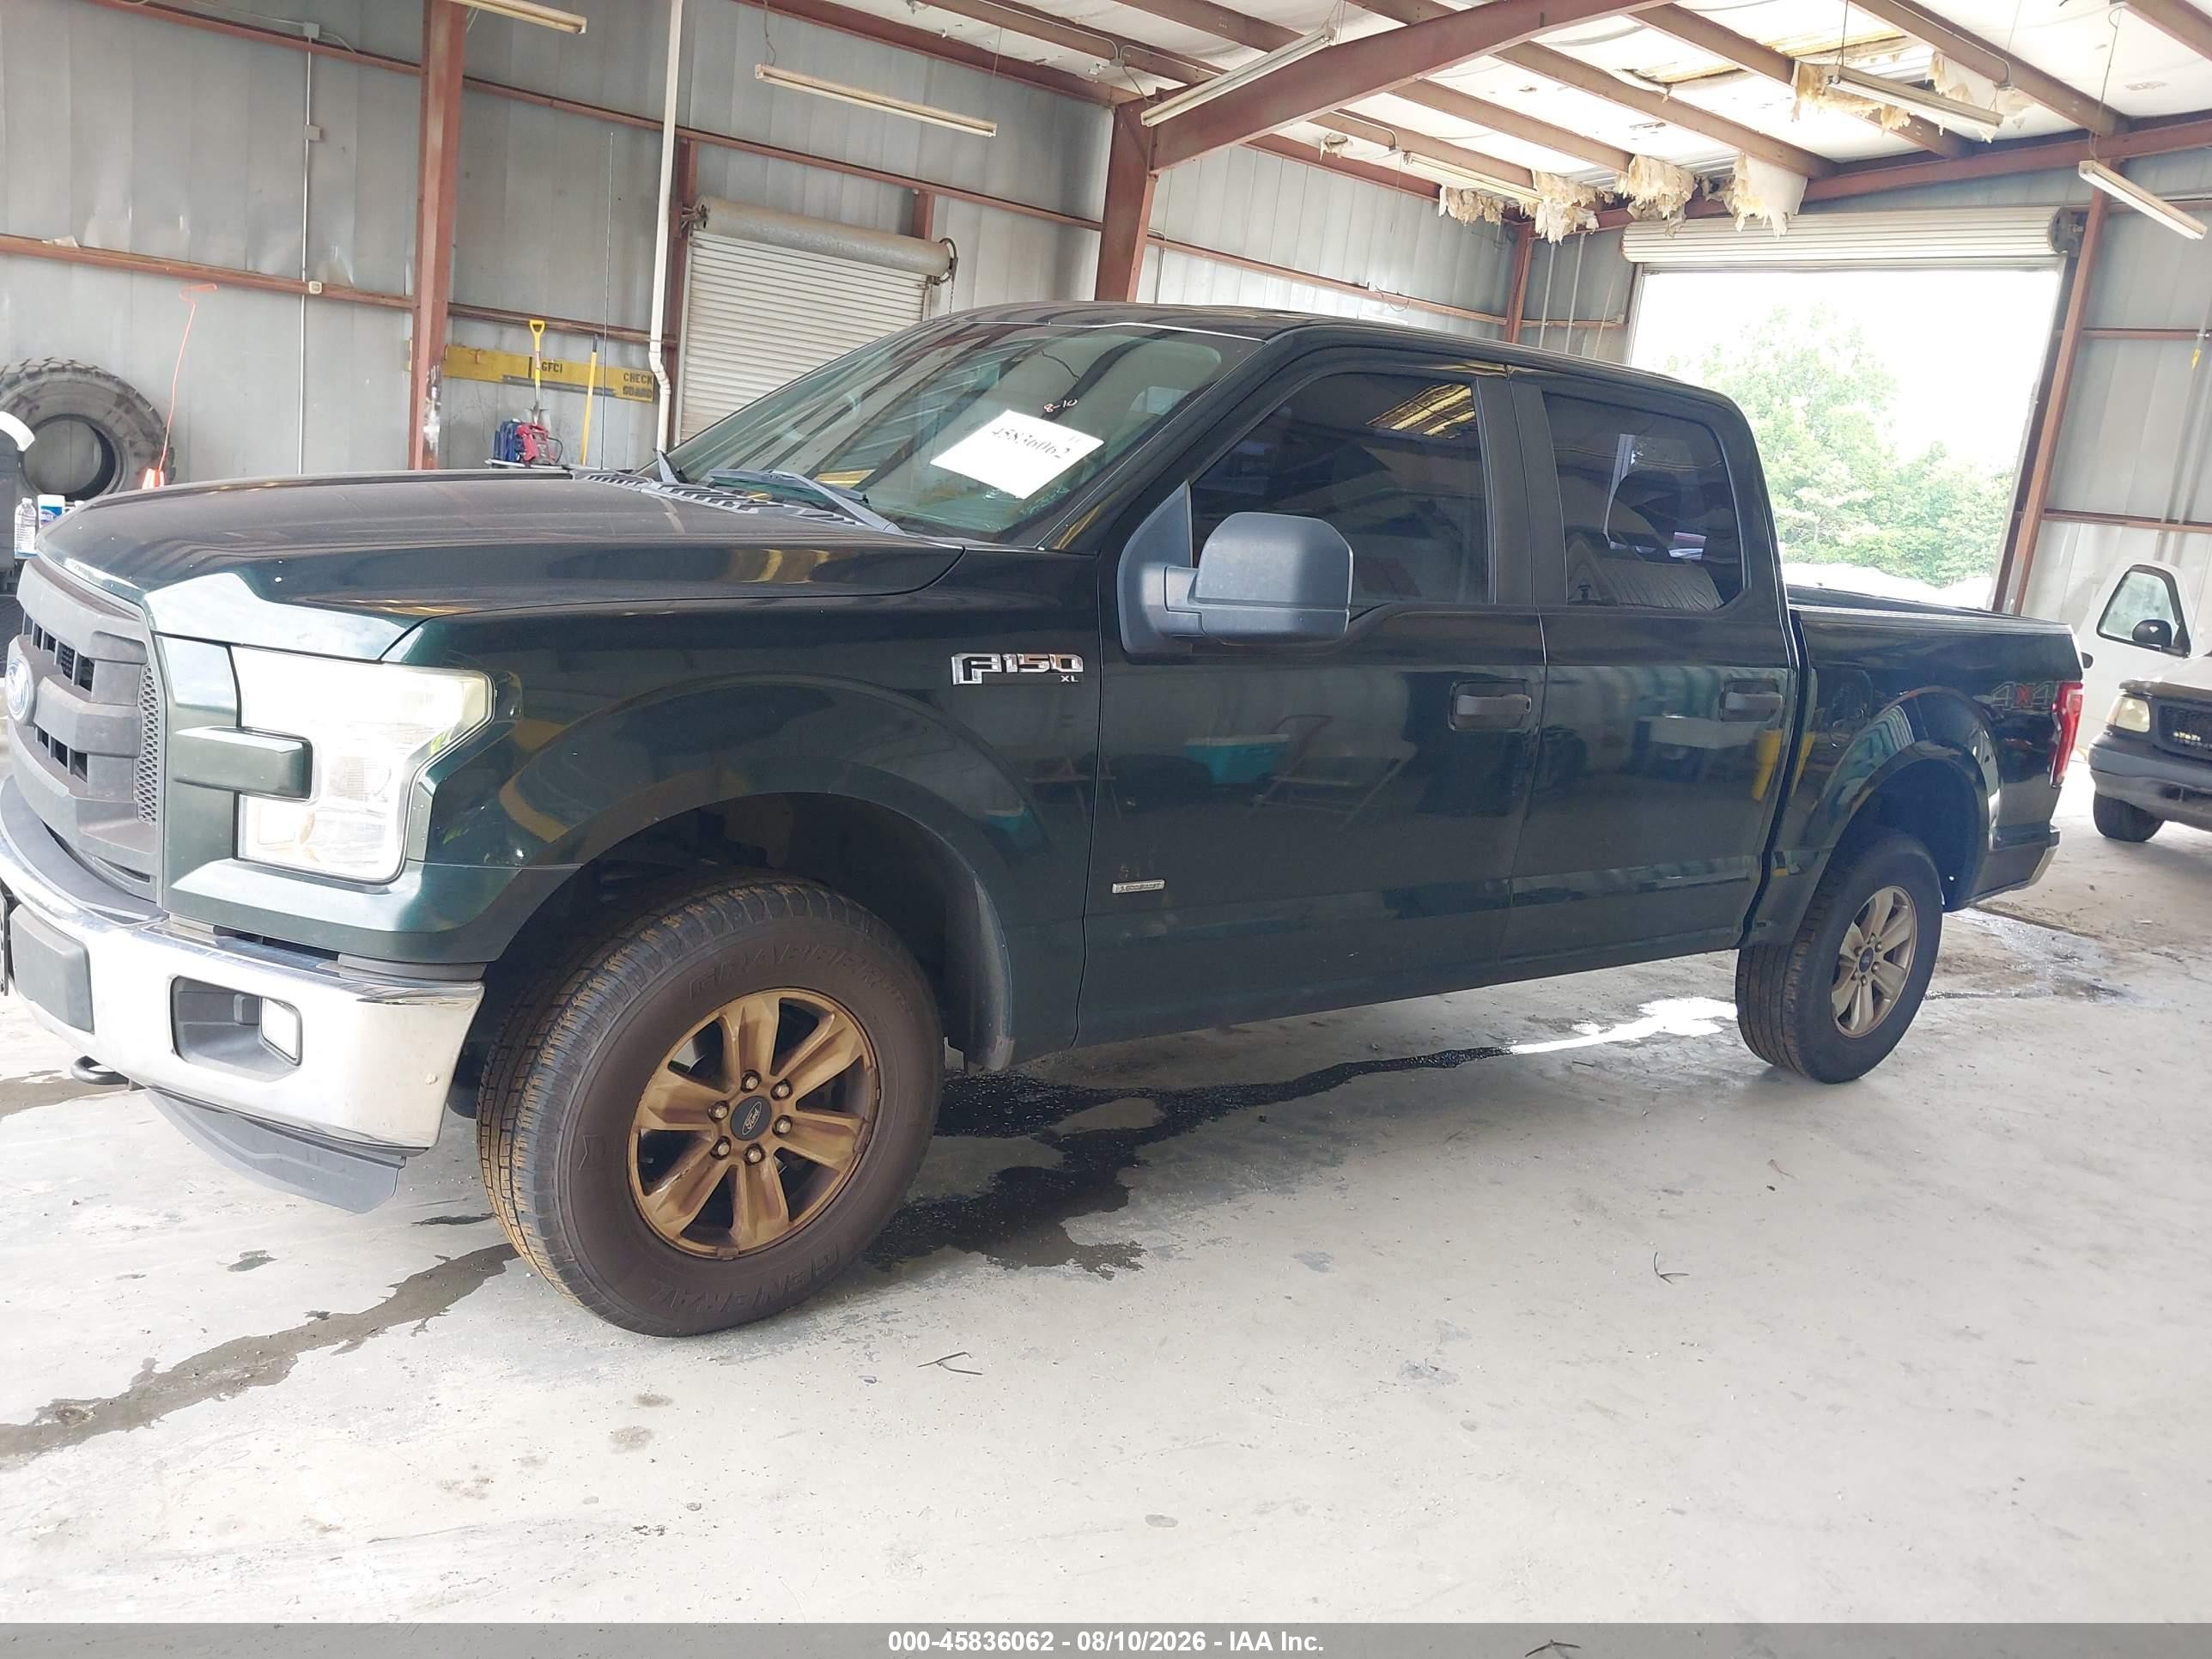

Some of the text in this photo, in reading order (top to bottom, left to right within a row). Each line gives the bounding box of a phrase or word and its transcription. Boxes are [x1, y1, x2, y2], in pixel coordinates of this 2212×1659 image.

[541, 361, 563, 374] GFCI
[623, 372, 653, 385] CHECK
[1043, 398, 1079, 413] 8-10
